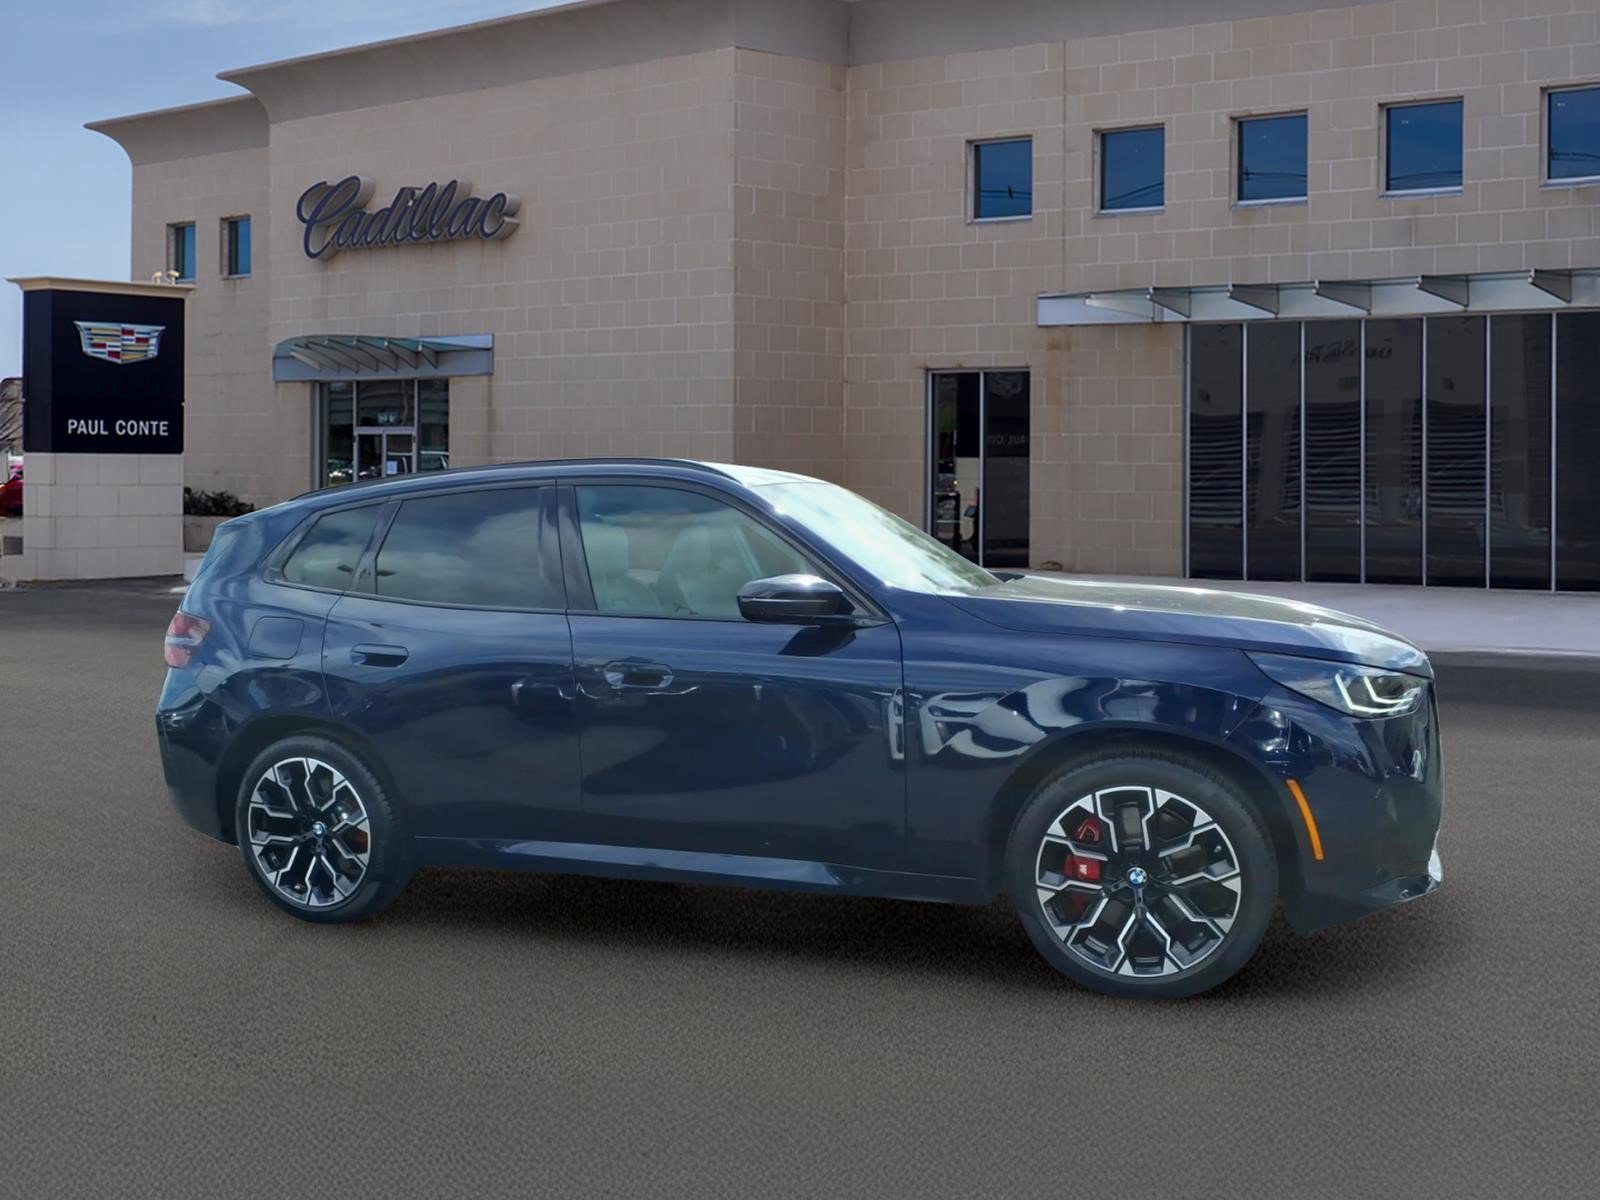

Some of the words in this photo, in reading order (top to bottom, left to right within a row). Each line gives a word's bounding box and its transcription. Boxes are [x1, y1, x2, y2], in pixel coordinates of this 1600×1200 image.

[296, 176, 512, 259] Cadillac
[67, 419, 108, 435] PAUL
[115, 420, 169, 436] CONTE
